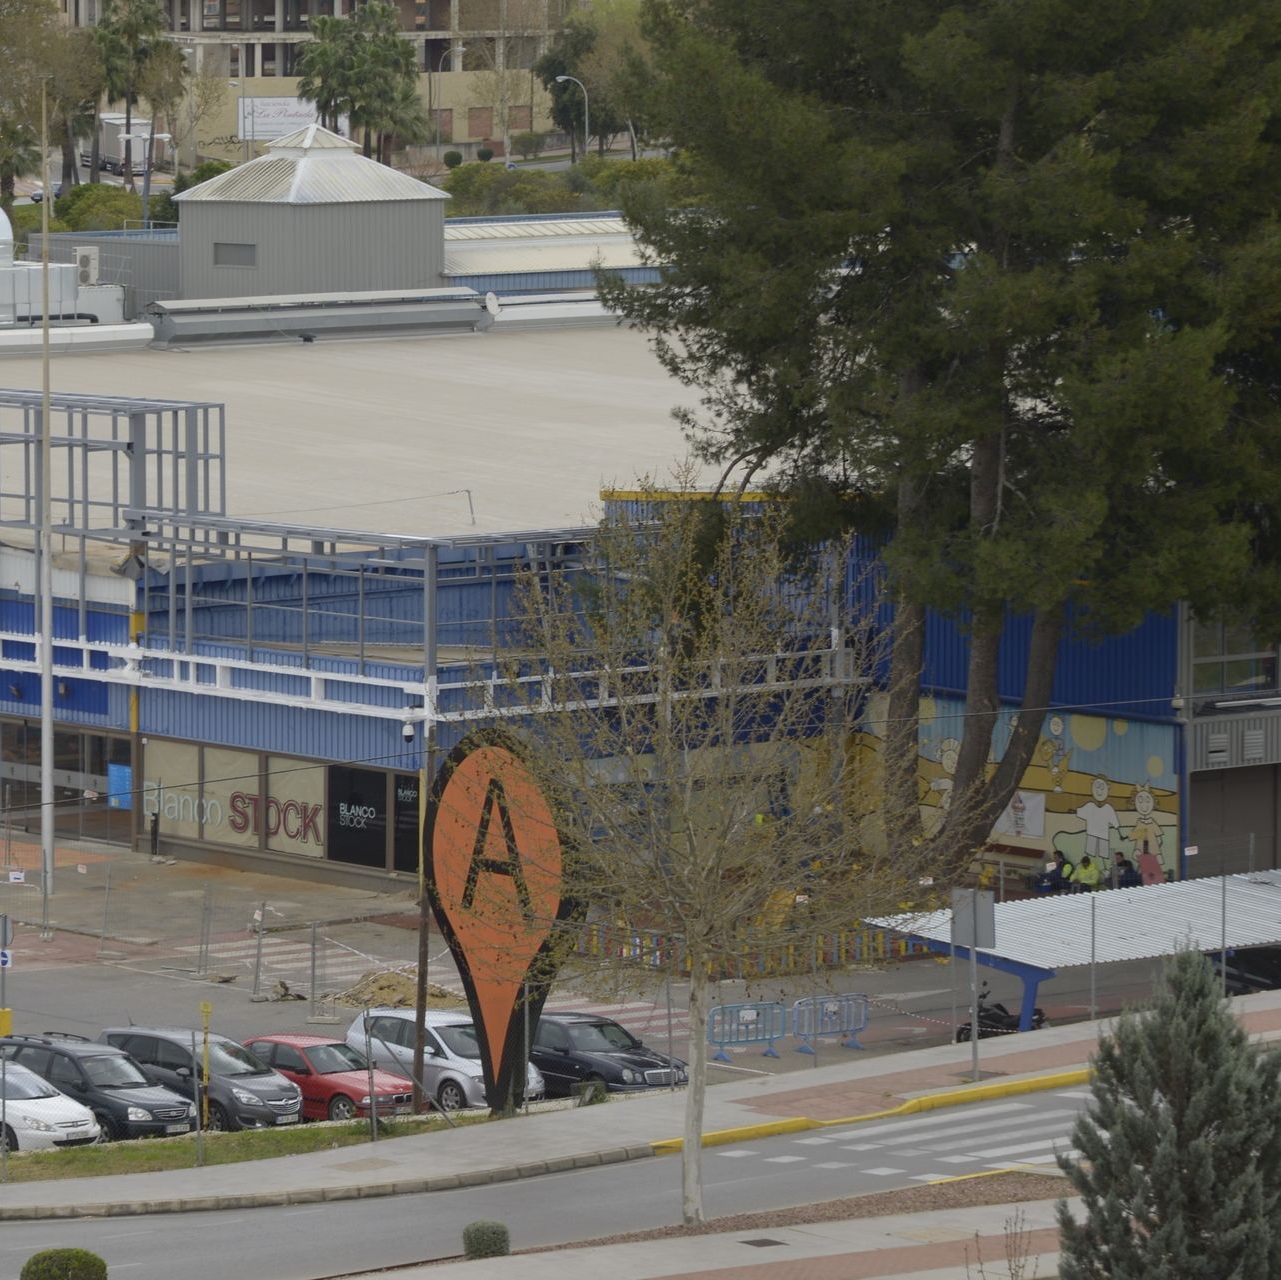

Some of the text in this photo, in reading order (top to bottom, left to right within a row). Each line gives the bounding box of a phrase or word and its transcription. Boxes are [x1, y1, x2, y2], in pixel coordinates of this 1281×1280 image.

[143, 780, 222, 826] Blanco
[228, 791, 324, 846] STOCK
[339, 802, 376, 819] BLANCO
[339, 814, 367, 829] STOCK
[461, 778, 535, 921] A
